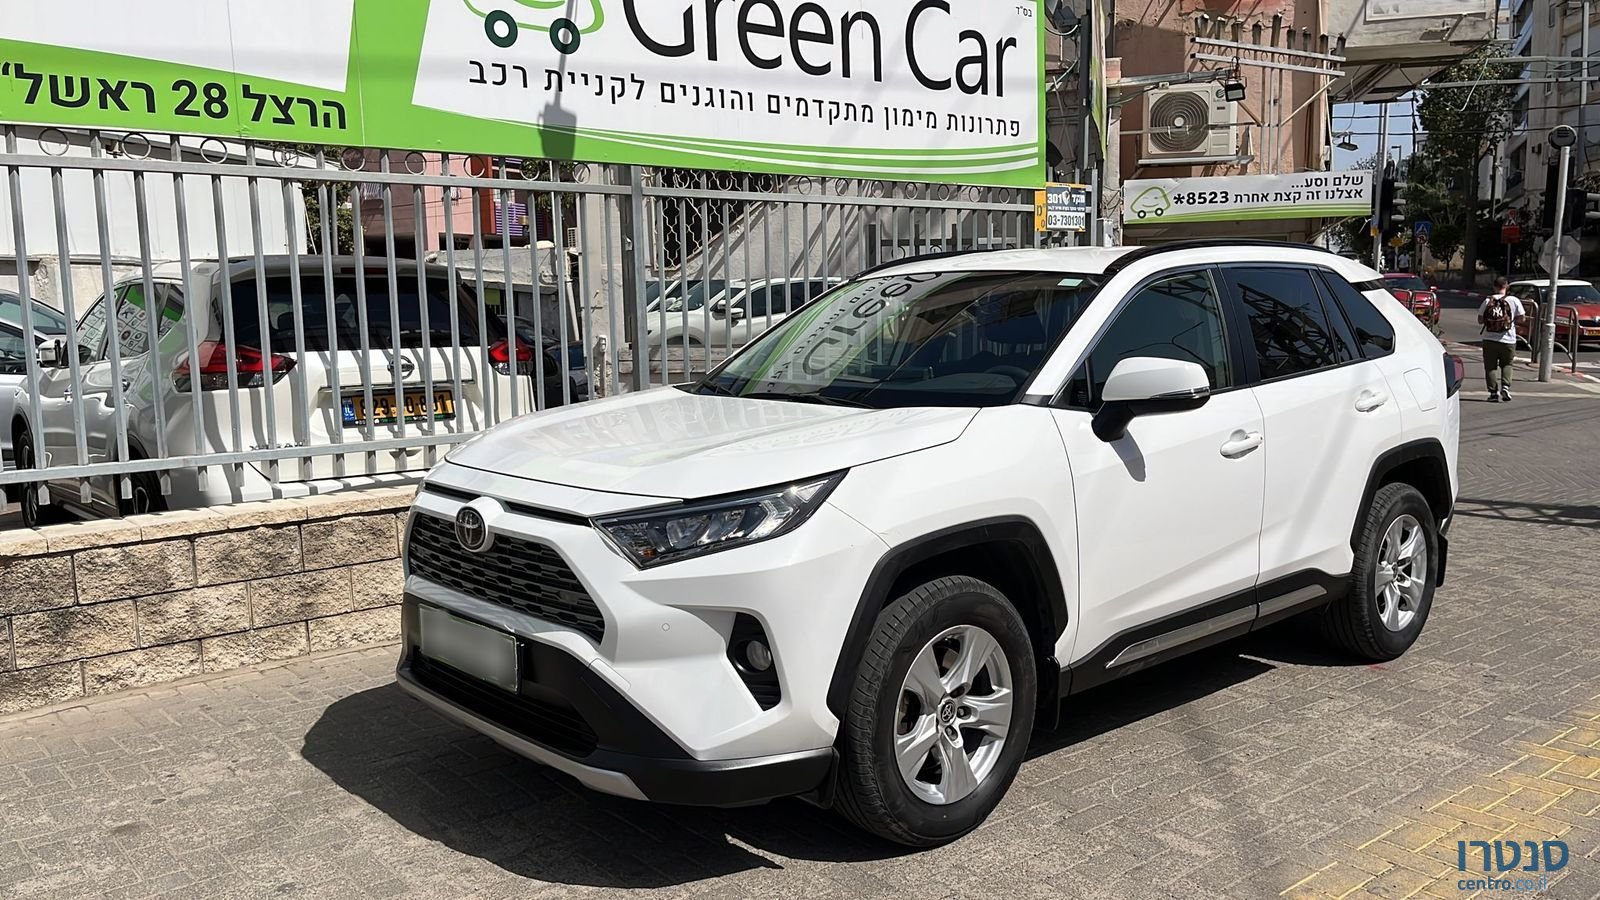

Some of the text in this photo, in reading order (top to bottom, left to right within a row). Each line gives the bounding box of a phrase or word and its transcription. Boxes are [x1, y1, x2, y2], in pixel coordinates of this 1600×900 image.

[623, 0, 1017, 98] Green Car
[171, 79, 229, 119] 28
[469, 60, 1020, 137] פתרונות מימון מתקדמים והוגנים לקניית רכב
[242, 83, 347, 130] הרצל
[1291, 174, 1364, 189] שלם וסע...
[1047, 193, 1062, 204] 301
[1233, 192, 1270, 204] אחרת
[1273, 191, 1301, 204] קצת
[1306, 190, 1321, 201] זה
[1325, 187, 1363, 200] אצלנו
[1047, 214, 1085, 227] 03-7301301
